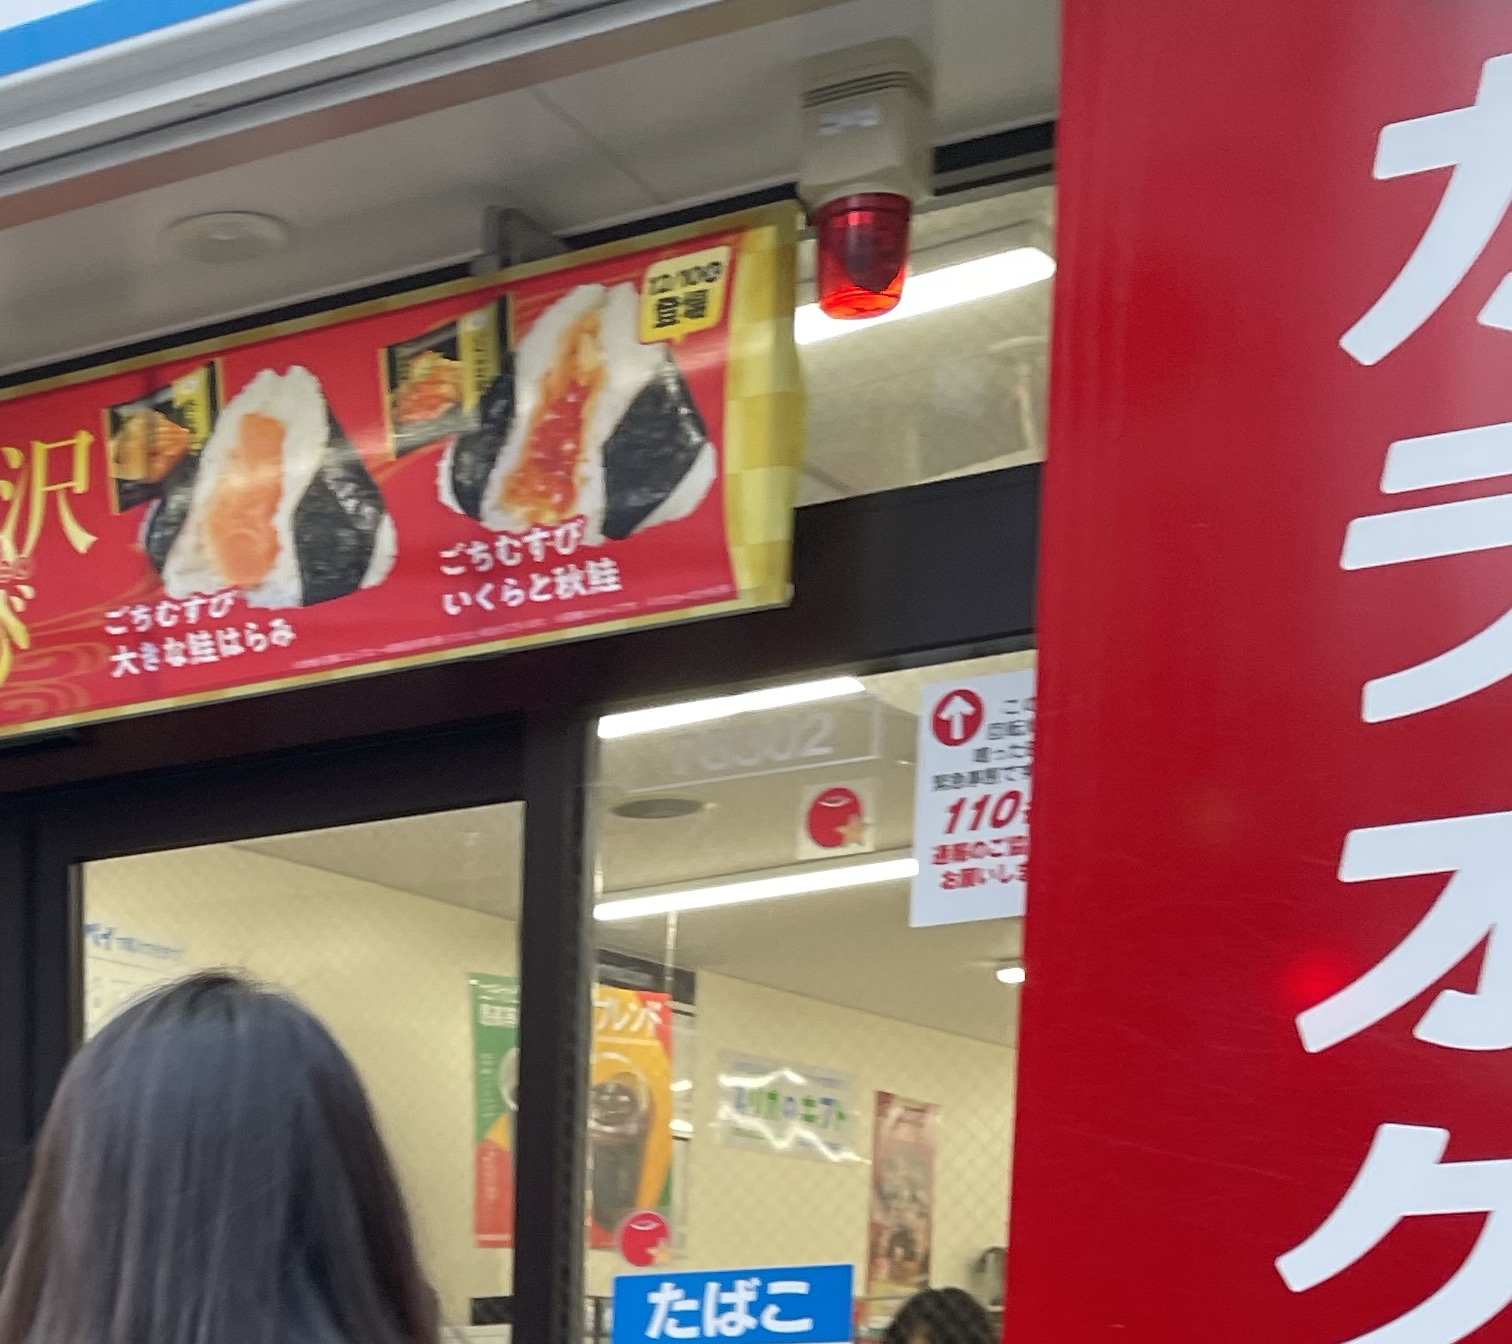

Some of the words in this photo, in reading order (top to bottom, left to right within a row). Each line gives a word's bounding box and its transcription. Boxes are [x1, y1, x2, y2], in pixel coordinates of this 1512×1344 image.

[652, 289, 709, 330] 登場
[440, 516, 586, 576] ごちむすび
[103, 589, 237, 636] ごちむすび
[442, 557, 623, 616] いくらと秋鮭
[110, 618, 297, 679] 大きな鮭はらみ
[944, 789, 1032, 836] 110
[643, 1277, 814, 1340] たばこ
